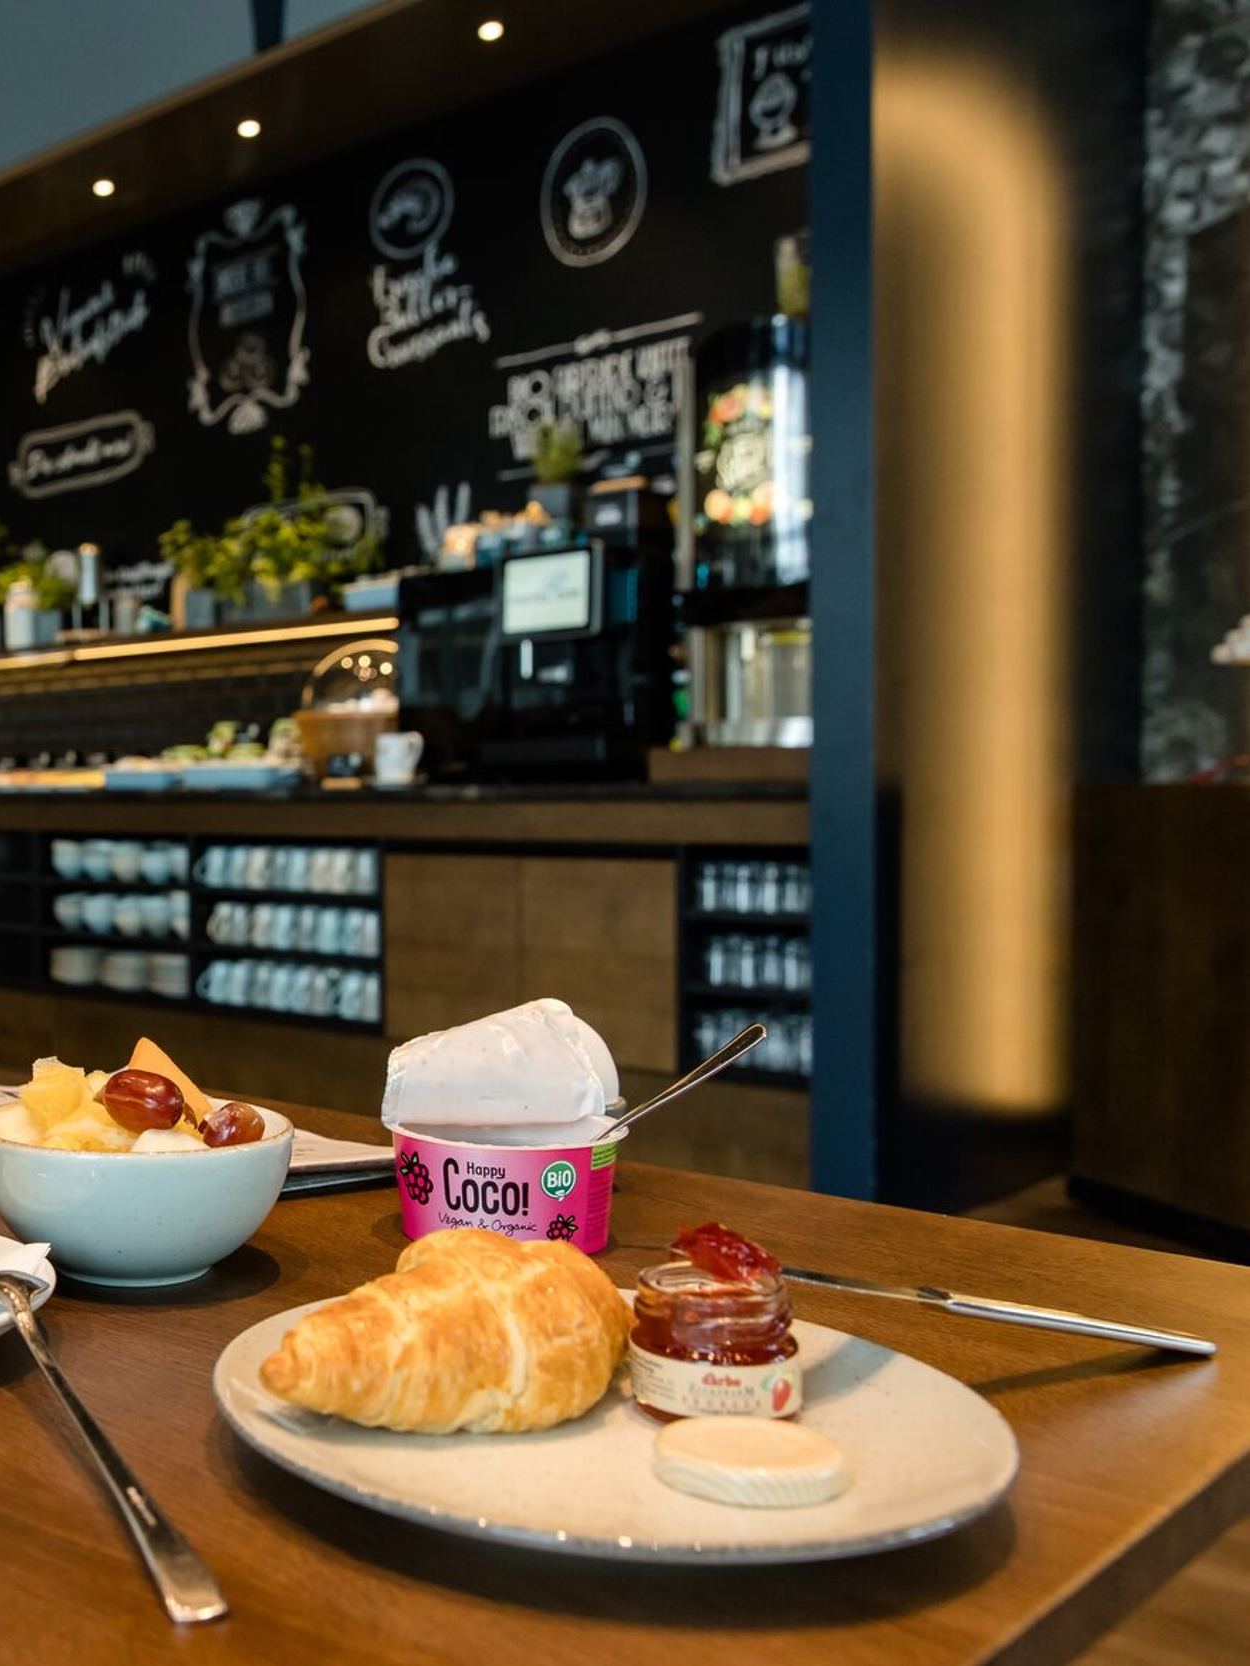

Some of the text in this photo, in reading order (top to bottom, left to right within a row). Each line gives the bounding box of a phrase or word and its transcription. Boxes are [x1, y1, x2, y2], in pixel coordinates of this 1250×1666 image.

[467, 1161, 506, 1179] Happy
[438, 1211, 538, 1237] Vegan & Organic
